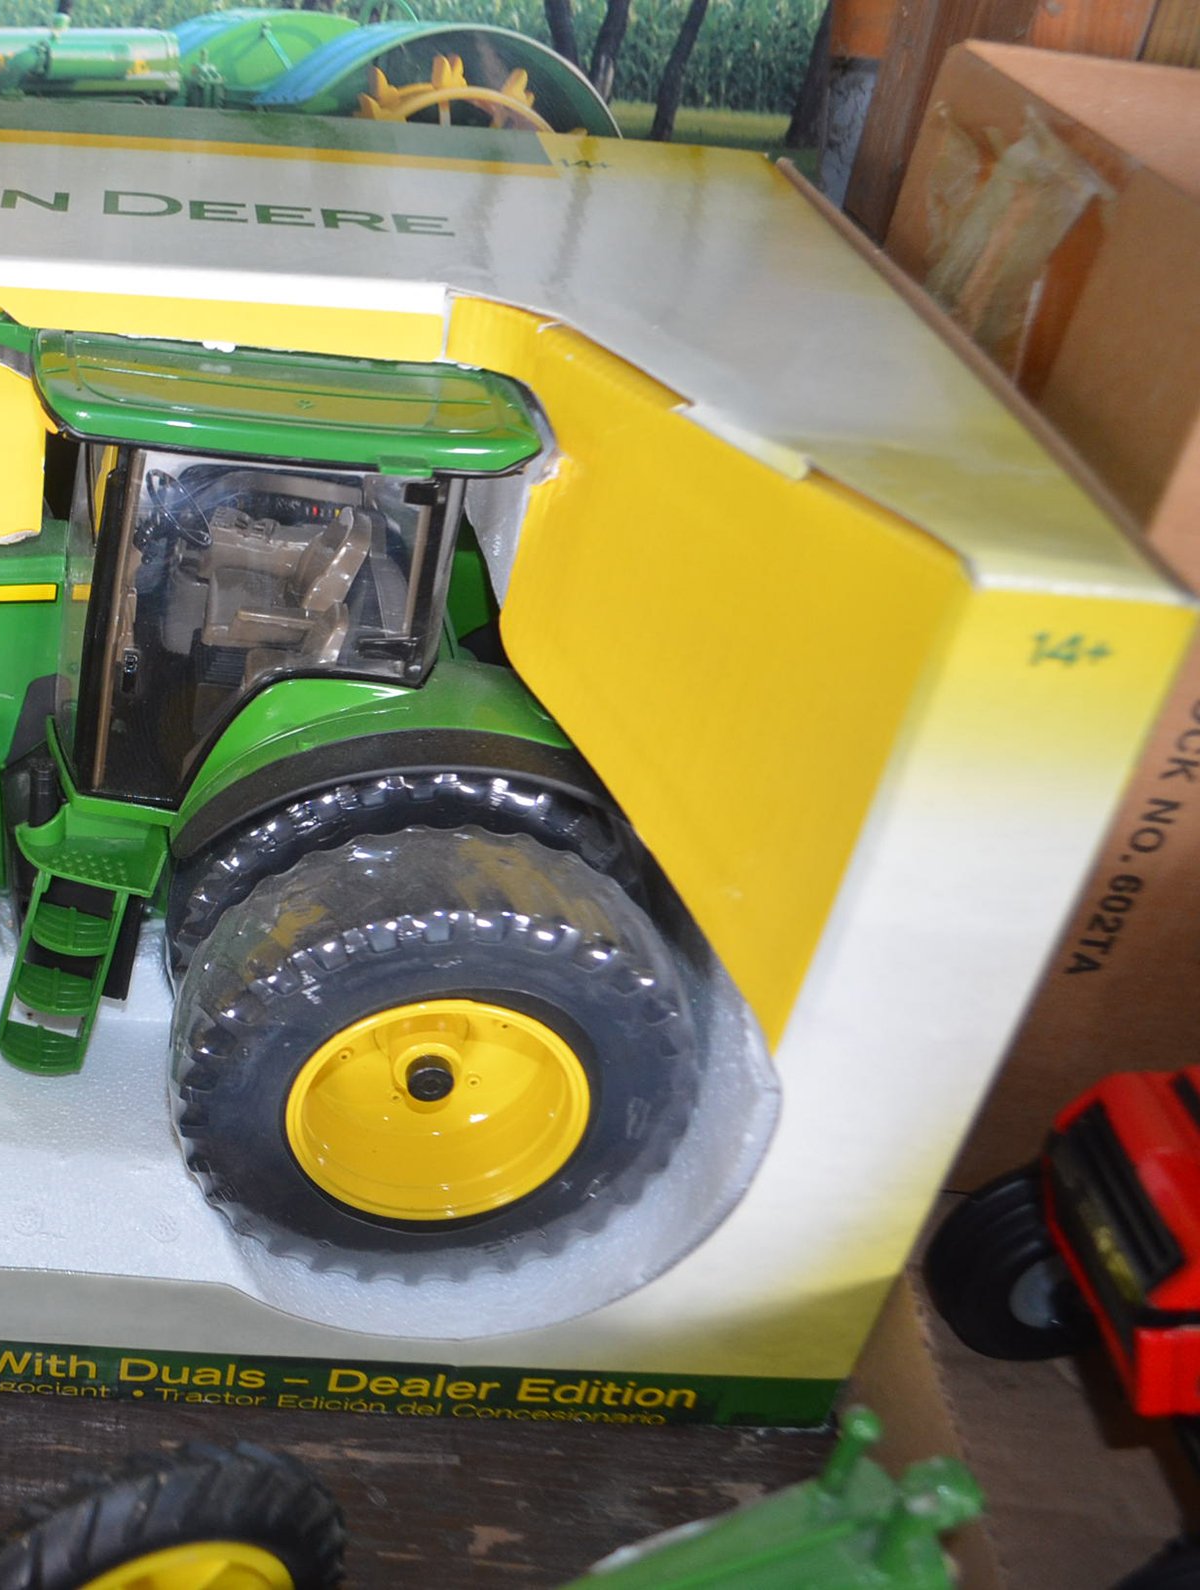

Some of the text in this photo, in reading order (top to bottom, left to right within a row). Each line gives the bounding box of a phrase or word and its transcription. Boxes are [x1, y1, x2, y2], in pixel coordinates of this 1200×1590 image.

[102, 189, 456, 237] DEERE
[1028, 631, 1112, 665] 14+
[1117, 797, 1183, 864] NO.
[1063, 872, 1145, 976] 602TA
[118, 1357, 266, 1389] Duals
[327, 1368, 501, 1401] Dealer
[516, 1376, 698, 1409] Edition
[154, 1387, 267, 1407] Tractor
[276, 1393, 388, 1415] Edición
[395, 1401, 443, 1416] del
[451, 1402, 668, 1426] Concesionario
